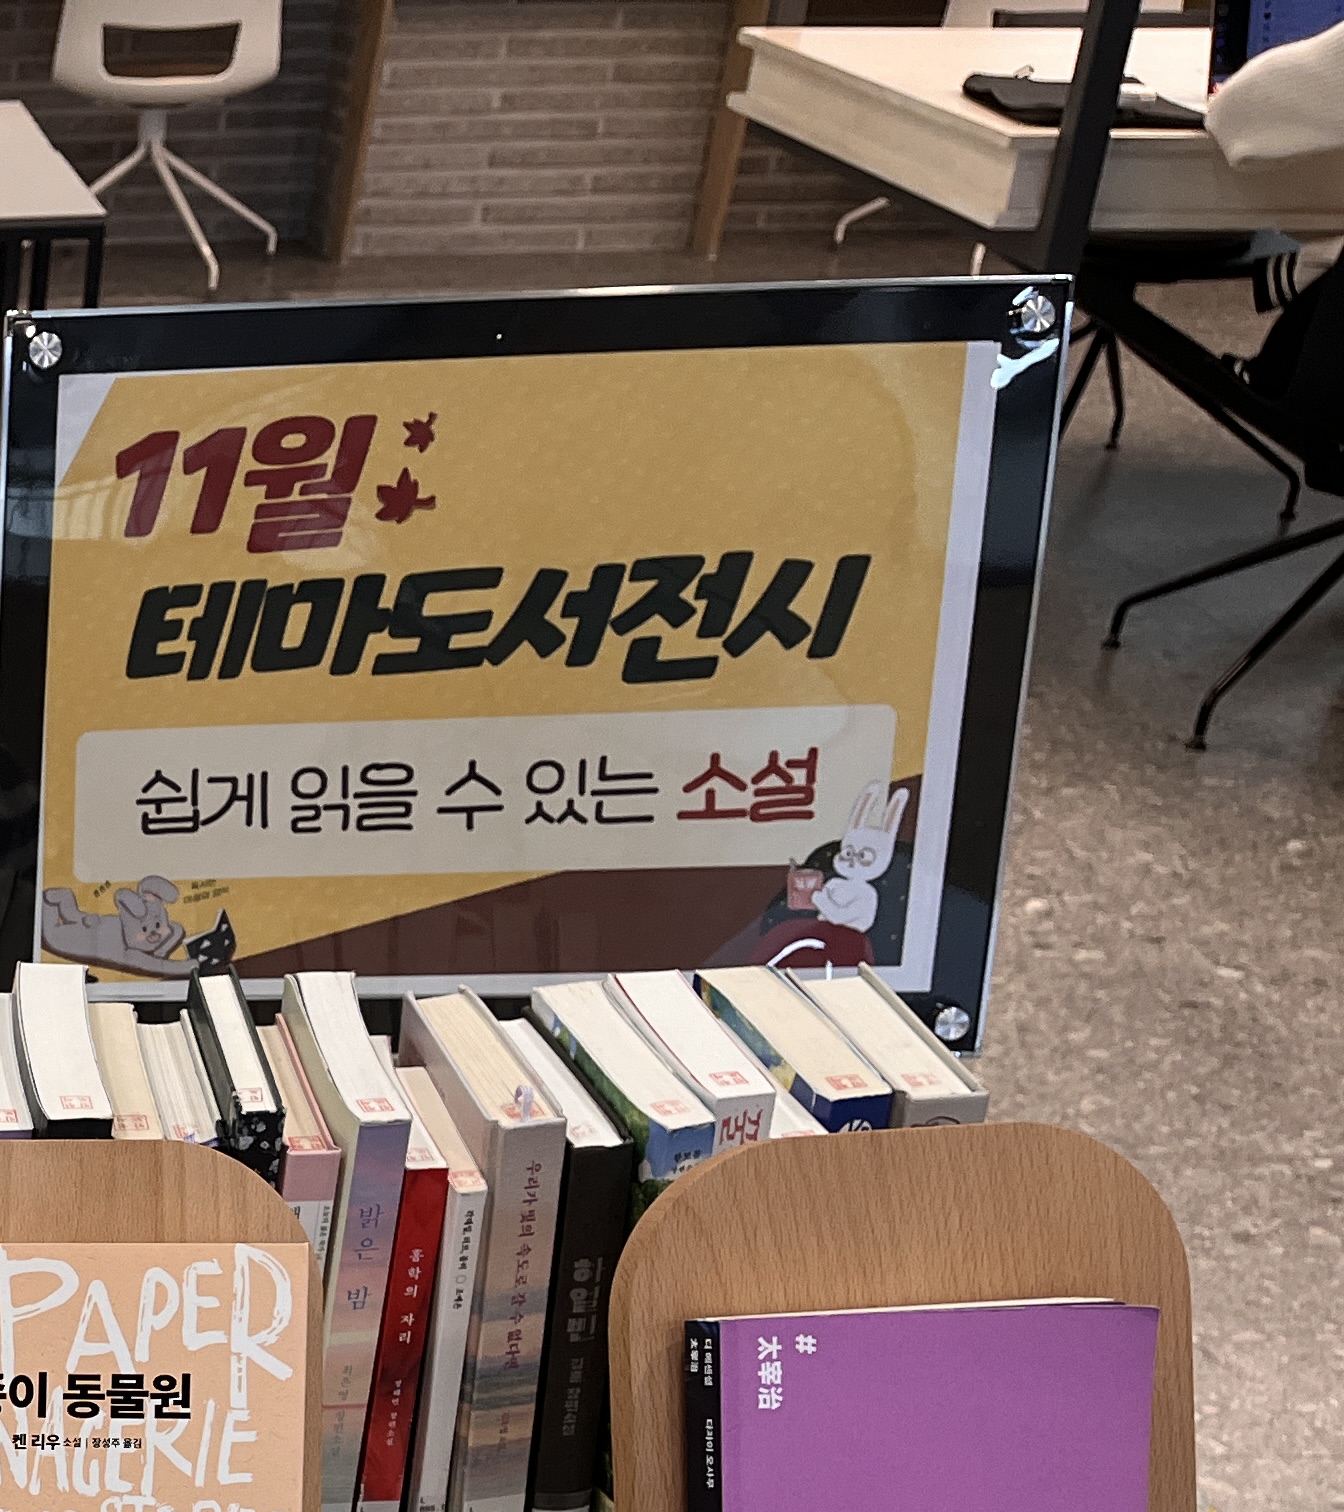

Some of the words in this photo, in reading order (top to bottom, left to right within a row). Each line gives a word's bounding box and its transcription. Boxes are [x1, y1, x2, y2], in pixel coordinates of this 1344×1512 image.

[114, 413, 378, 553] 11월
[125, 550, 873, 685] 테마도서전시
[136, 764, 269, 835] 쉽게
[289, 760, 418, 835] 읽을
[436, 758, 504, 832] 수
[523, 754, 659, 826] 있는
[676, 746, 821, 826] 소설
[521, 1159, 543, 1205] 우리가
[354, 1204, 385, 1261] 밝은
[347, 1285, 373, 1311] 밤
[703, 1338, 713, 1350] 디
[62, 1371, 192, 1420] 동물원
[756, 1335, 784, 1412] 太宰治
[12, 1433, 27, 1449] 켄
[31, 1433, 60, 1450] 리우
[63, 1437, 82, 1448] 소설
[91, 1437, 120, 1449] 장성주
[123, 1437, 143, 1449] 옮김
[705, 1418, 715, 1452] 다자이
[705, 1455, 715, 1490] 오사무
